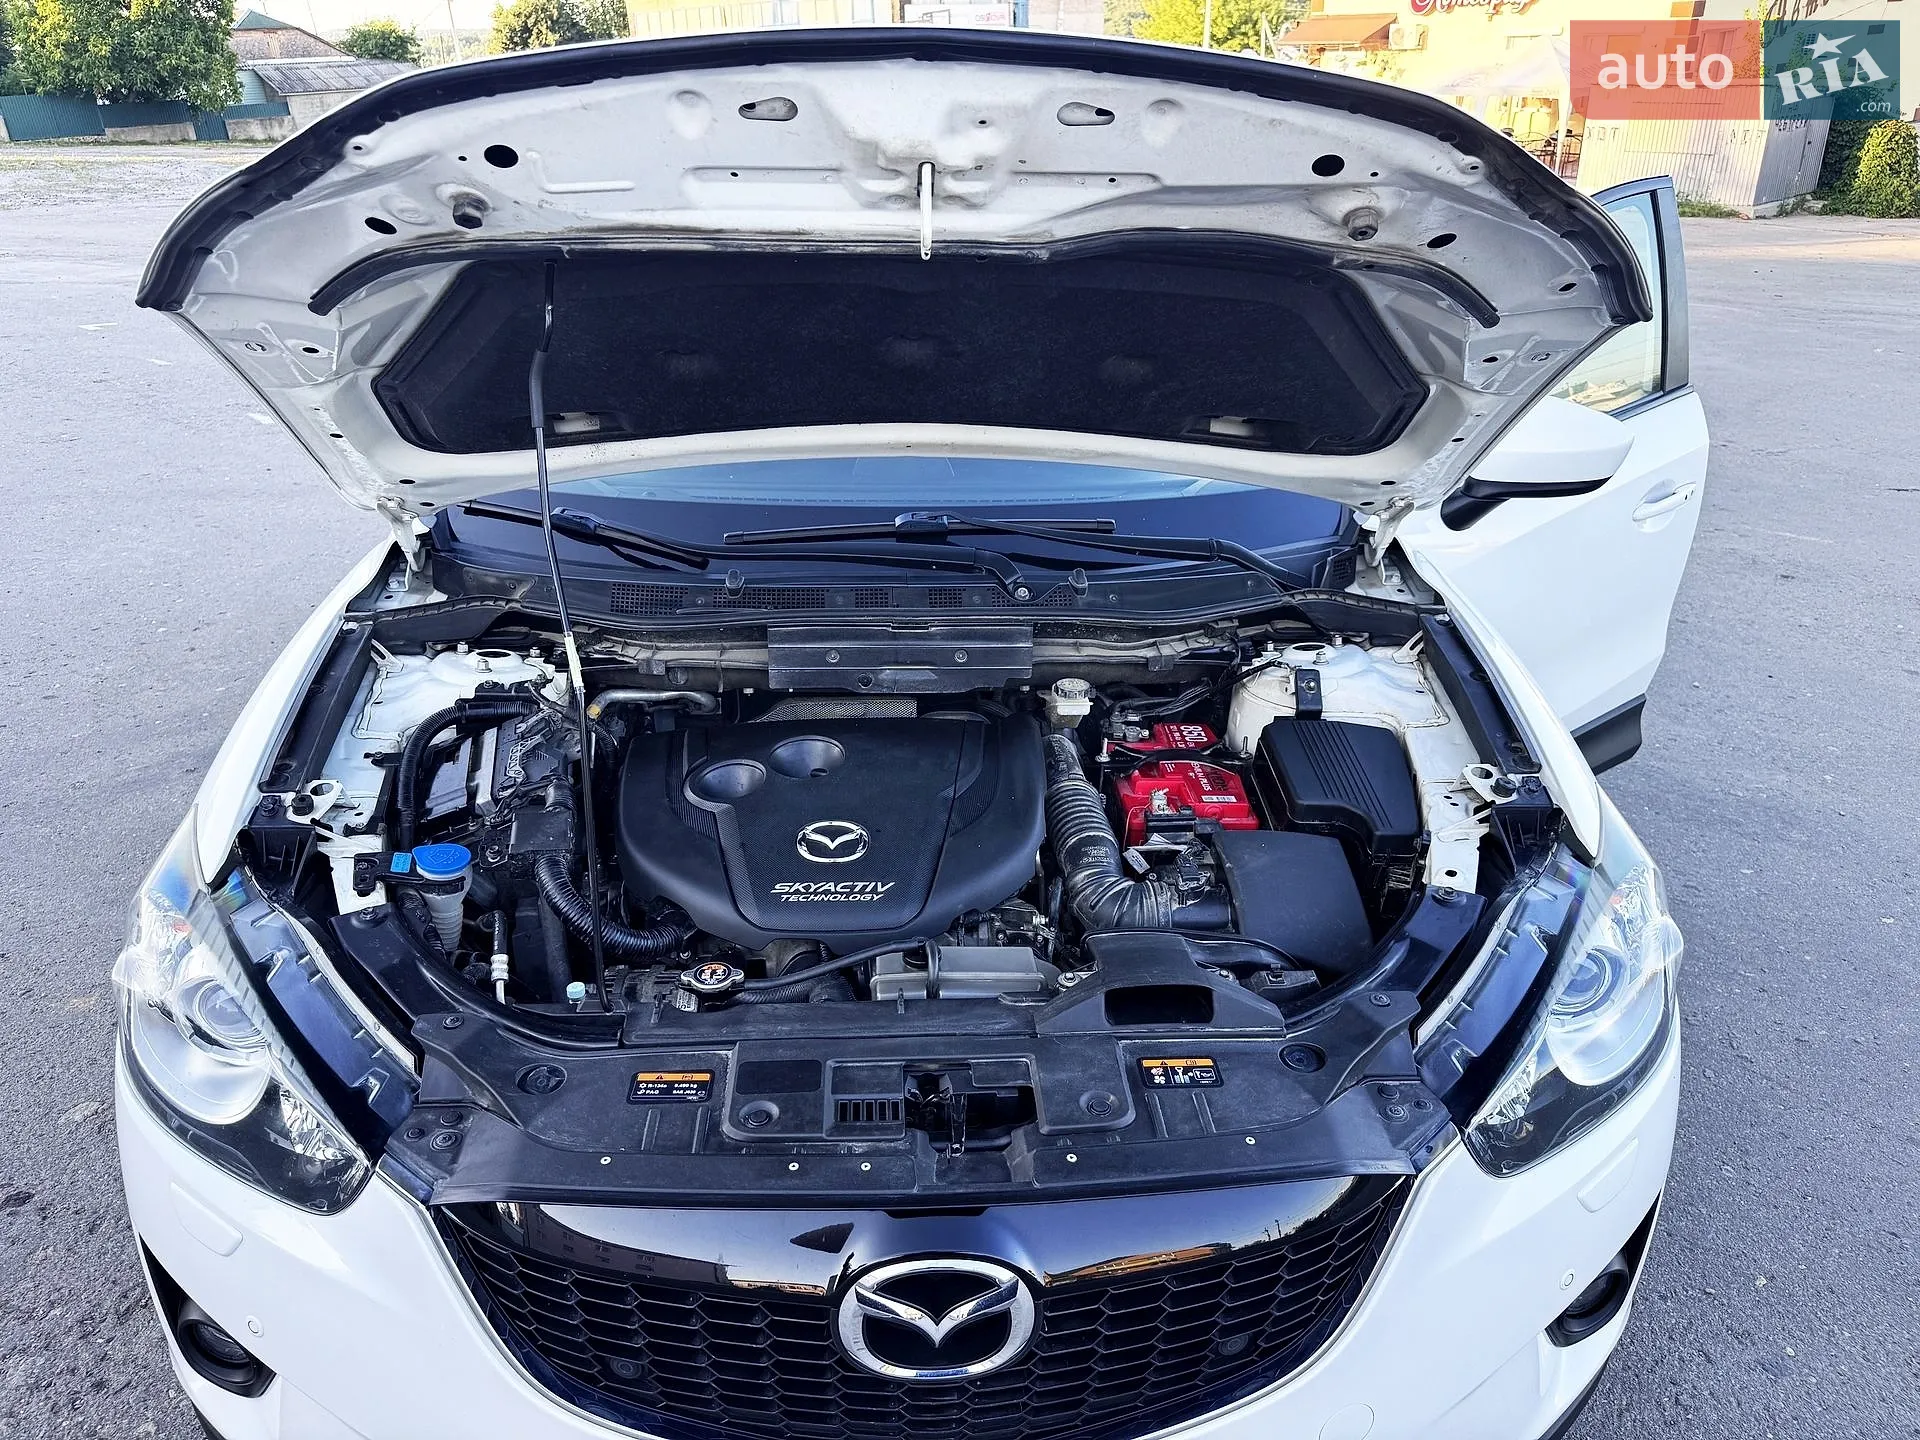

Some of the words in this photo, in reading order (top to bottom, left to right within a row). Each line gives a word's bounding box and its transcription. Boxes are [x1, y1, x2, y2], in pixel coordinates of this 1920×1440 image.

[1180, 725, 1208, 742] 850
[770, 881, 896, 893] SKYACTIV
[780, 893, 884, 902] TECHNOLOGY
